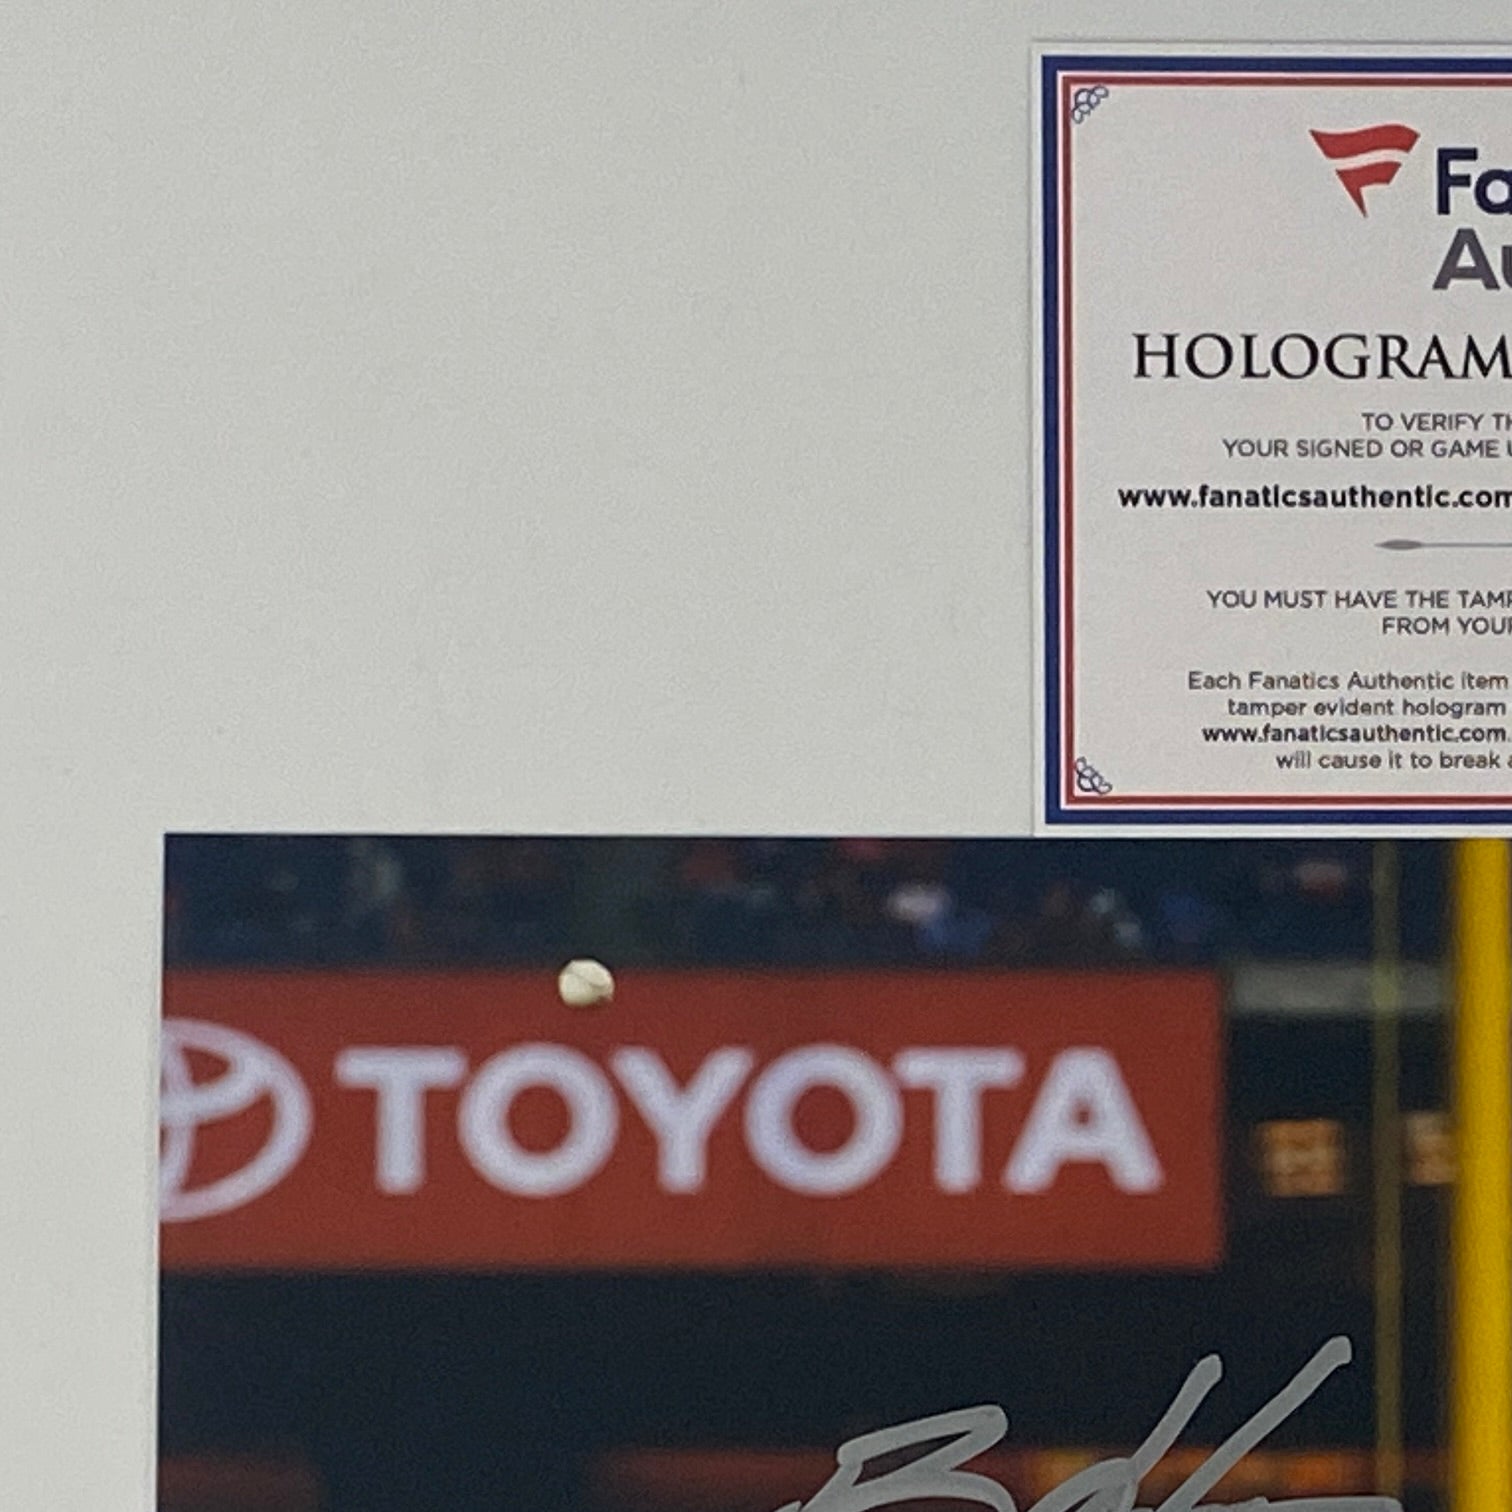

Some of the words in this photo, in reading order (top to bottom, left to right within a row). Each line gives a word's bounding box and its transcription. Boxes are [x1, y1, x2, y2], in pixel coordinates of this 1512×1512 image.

[1361, 412, 1394, 432] TO
[1400, 412, 1485, 432] VERIFY
[1222, 438, 1289, 458] YOUR
[1296, 438, 1384, 459] SIGNED
[1390, 439, 1424, 458] OR
[1430, 439, 1500, 459] GAME
[1206, 589, 1257, 609] YOU
[1263, 589, 1328, 609] MUST
[1334, 589, 1398, 609] HAVE
[1404, 589, 1450, 609] THE
[1382, 616, 1450, 636] FROM
[1188, 670, 1242, 690] Each
[1248, 670, 1340, 690] Fanatics
[1347, 671, 1455, 691] Authentic
[1461, 671, 1509, 690] item
[1227, 698, 1308, 719] tamper
[1313, 697, 1395, 716] evident
[1402, 697, 1507, 720] hologram
[1201, 722, 1512, 743] www.fanaticsauthentic.com.
[1275, 750, 1311, 769] will
[1317, 754, 1382, 769] cause
[1388, 750, 1403, 770] it
[1410, 752, 1433, 770] to
[1439, 750, 1501, 769] break
[333, 1041, 1165, 1199] TOYOTA
